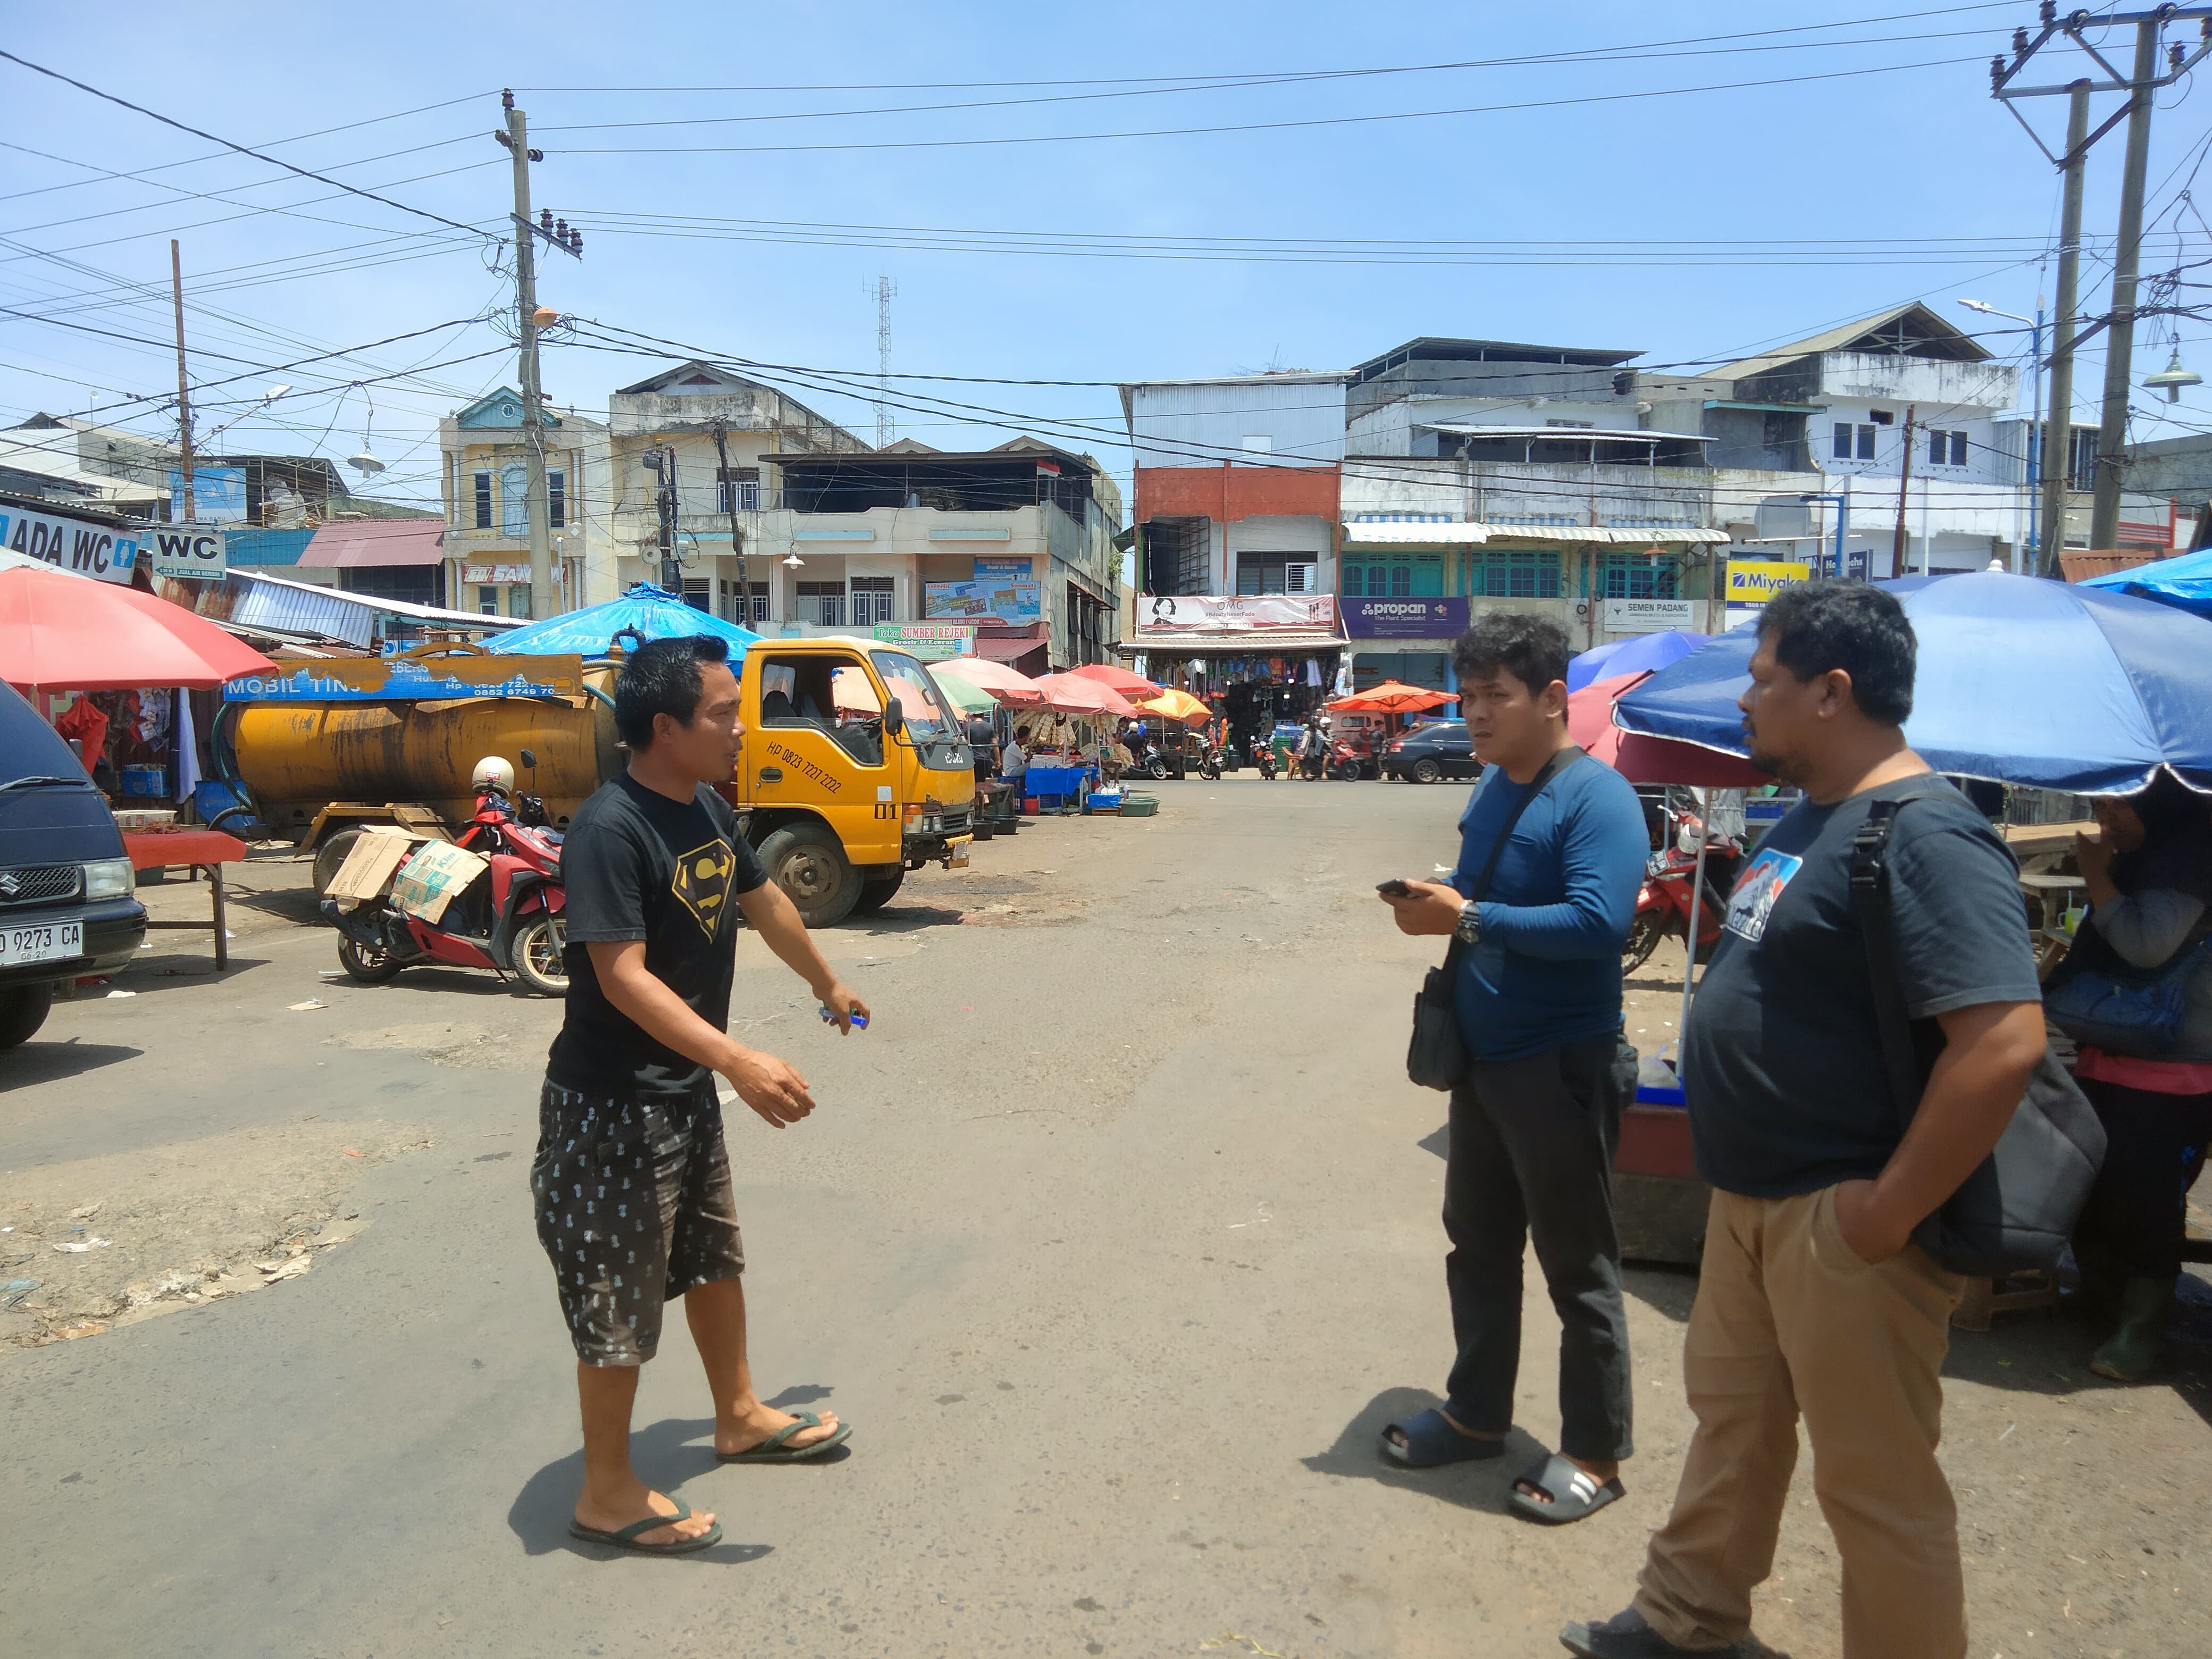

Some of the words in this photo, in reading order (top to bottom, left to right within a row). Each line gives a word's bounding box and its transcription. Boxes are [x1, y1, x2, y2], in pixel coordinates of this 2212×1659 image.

[11, 519, 63, 567] ADA
[72, 529, 112, 574] WC
[157, 534, 218, 559] WC
[1217, 601, 1243, 610] OMG
[1374, 604, 1427, 615] propan
[877, 629, 899, 638] Toko
[901, 627, 935, 638] SUMBER
[938, 627, 969, 638] REJEKI
[228, 679, 300, 694] MOBIL
[766, 741, 783, 756] HP
[782, 749, 803, 769] 0823
[801, 761, 823, 781] 7227
[820, 774, 842, 794] 2222
[874, 803, 898, 820] 01
[14, 928, 52, 951] 9273
[62, 925, 79, 945] CA
